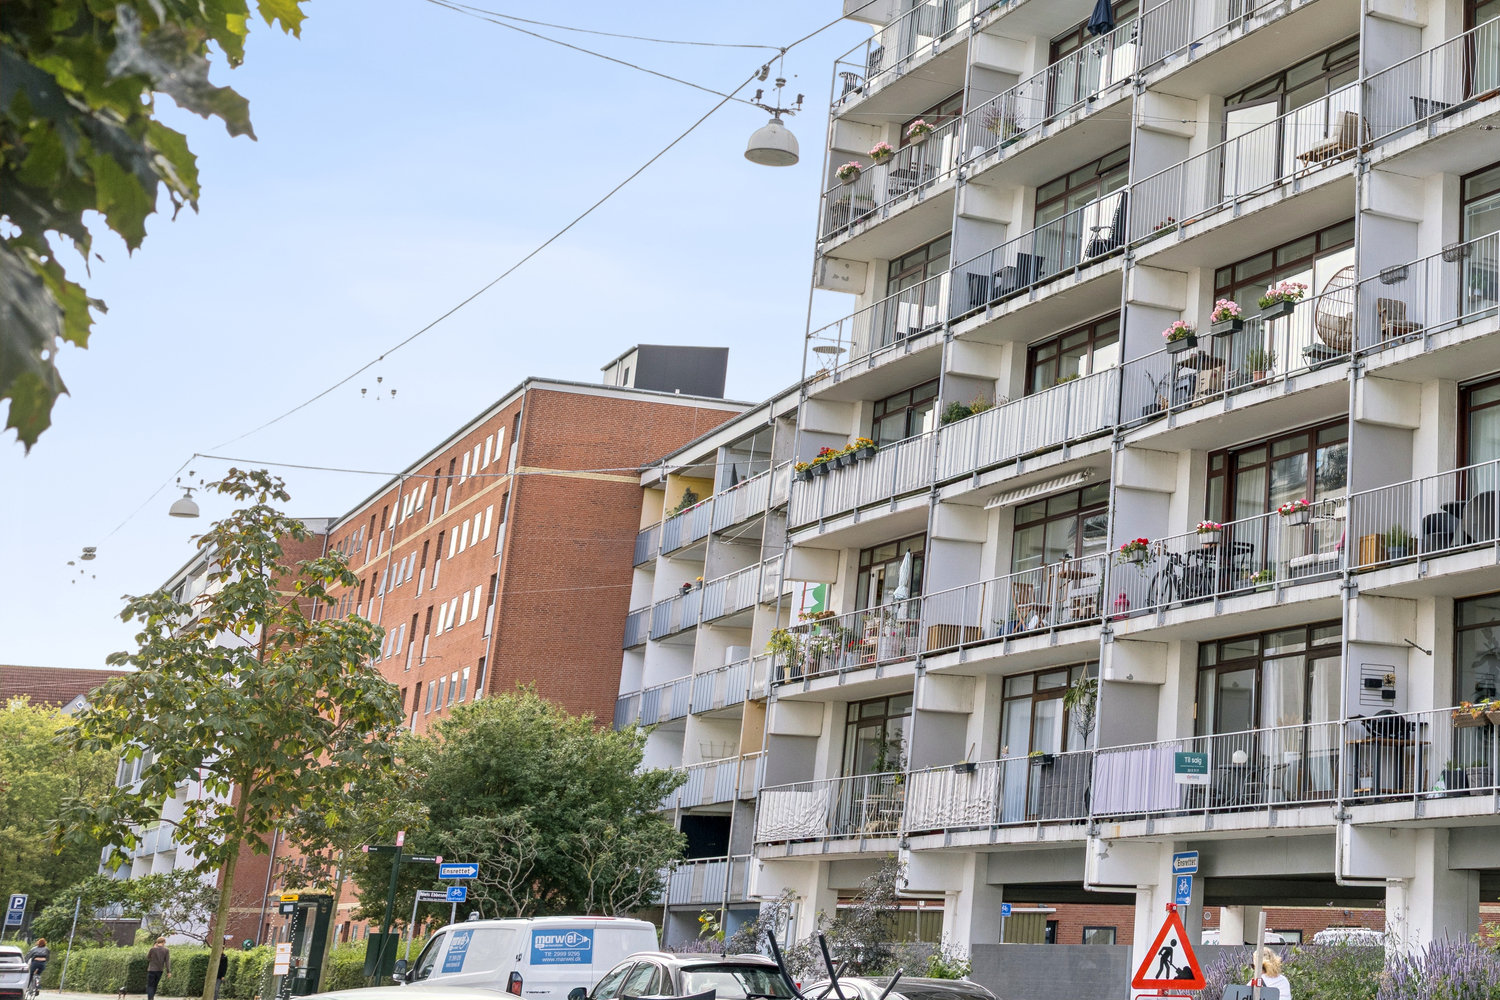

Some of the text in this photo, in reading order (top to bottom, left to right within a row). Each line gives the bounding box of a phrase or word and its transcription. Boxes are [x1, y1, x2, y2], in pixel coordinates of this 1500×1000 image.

[1192, 757, 1202, 766] salg
[13, 897, 24, 909] P
[535, 933, 577, 944] marwel
